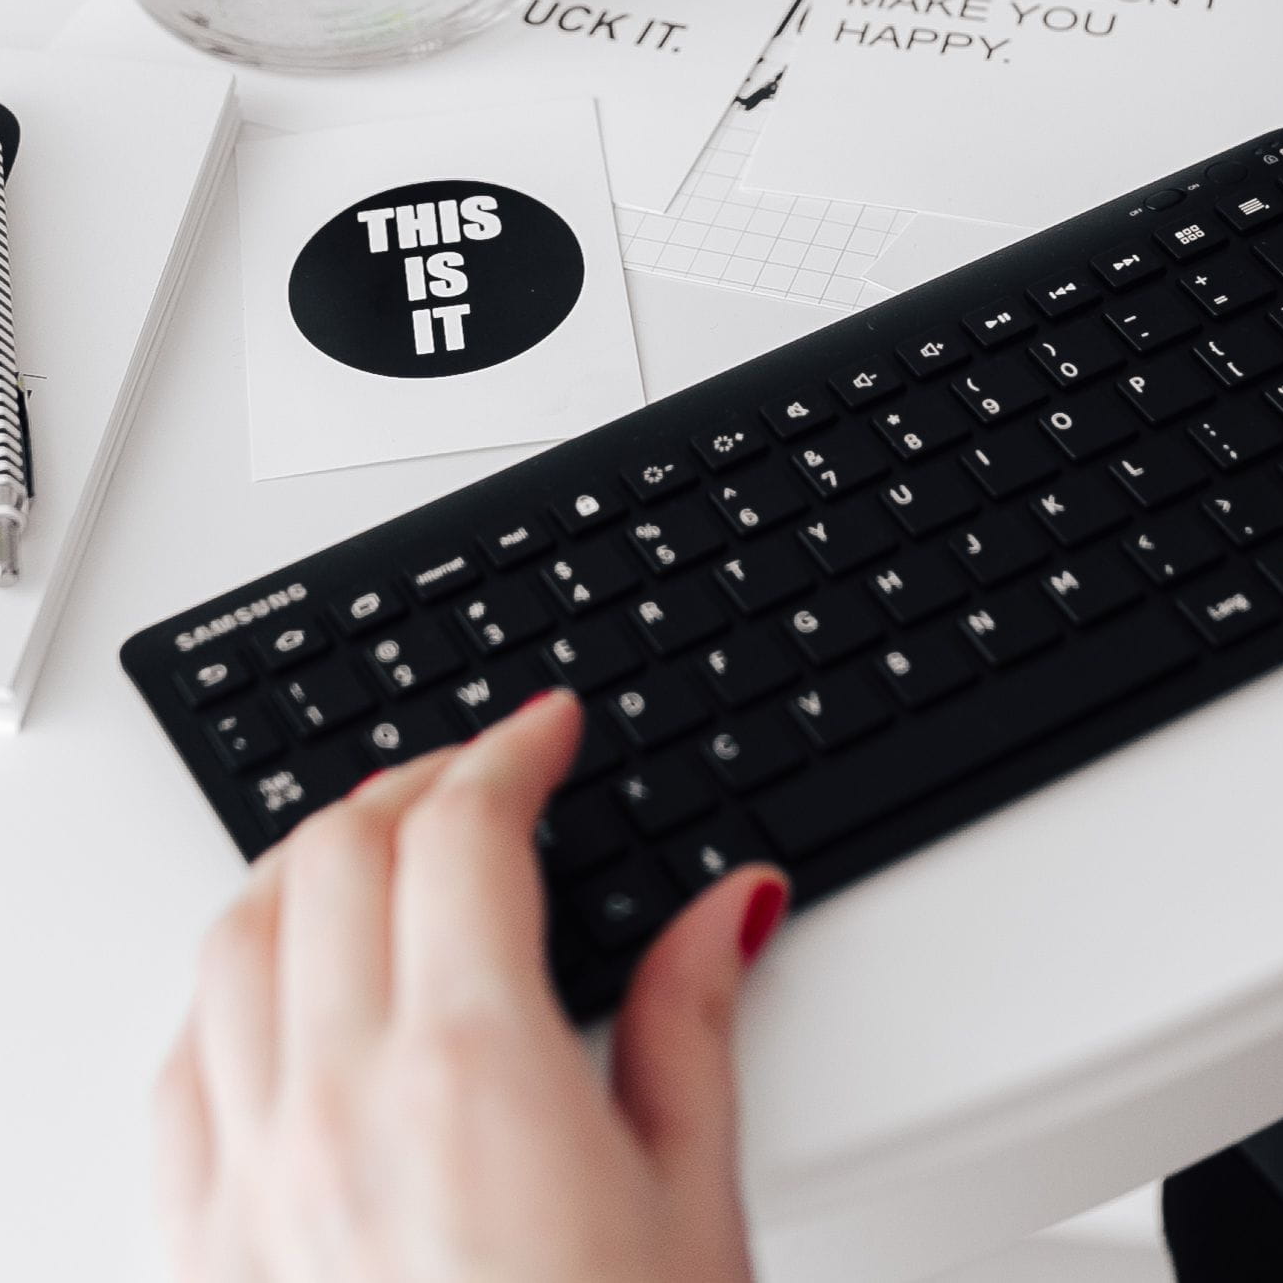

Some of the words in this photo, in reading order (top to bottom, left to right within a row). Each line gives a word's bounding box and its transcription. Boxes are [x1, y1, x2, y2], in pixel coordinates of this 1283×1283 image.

[636, 19, 688, 54] IT.
[833, 21, 1012, 64] HAPPY.
[1011, 0, 1118, 38] YOU
[357, 194, 503, 254] THIS
[404, 251, 470, 303] IS
[412, 304, 471, 356] IT
[967, 533, 982, 555] J
[1041, 494, 1065, 516] K
[1121, 460, 1145, 477] L
[457, 678, 491, 707] W
[553, 639, 575, 663] E
[725, 559, 745, 580] T
[807, 522, 828, 542] Y
[889, 484, 913, 505] U
[1128, 376, 1146, 394] P
[1050, 570, 1079, 595] M
[174, 583, 308, 652] SAMSUNG
